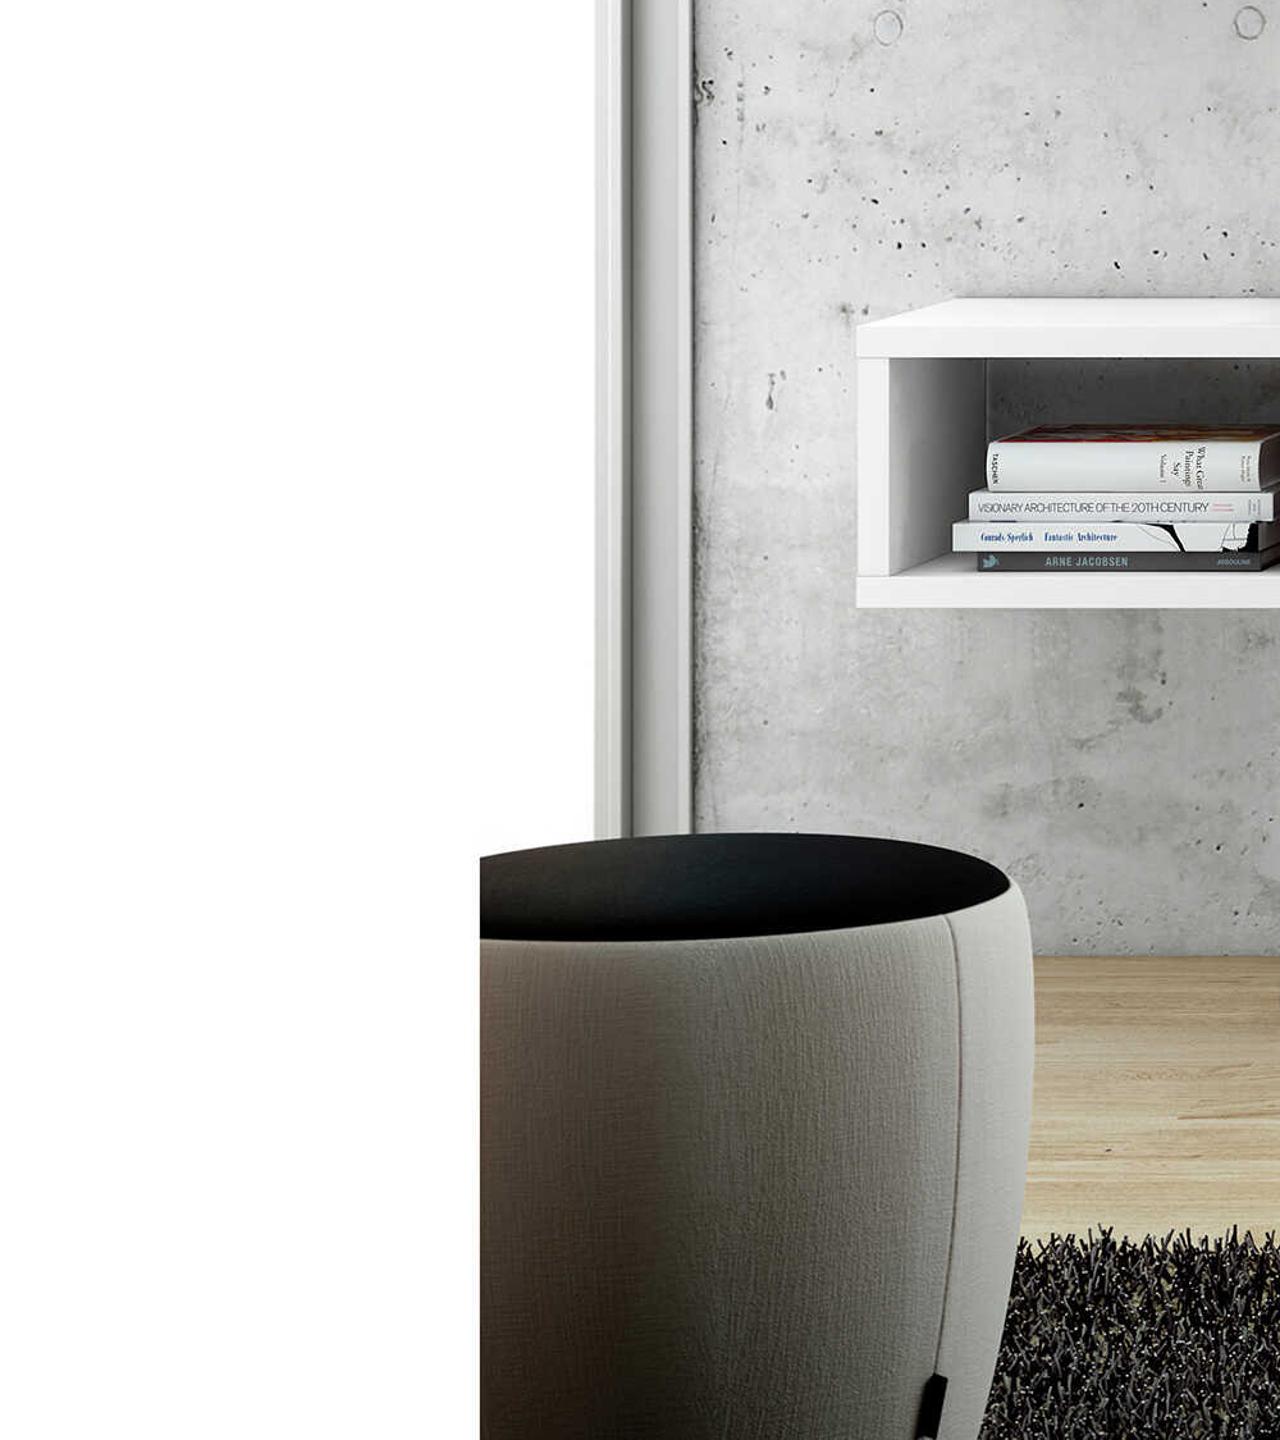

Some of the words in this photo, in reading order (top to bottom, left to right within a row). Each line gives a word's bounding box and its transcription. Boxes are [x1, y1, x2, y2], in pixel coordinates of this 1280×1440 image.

[1170, 461, 1181, 476] Say
[977, 502, 1024, 514] VISIONARY
[1023, 502, 1094, 514] ARCHITECTURE
[1094, 502, 1111, 514] OF
[1110, 502, 1130, 514] THE
[1130, 502, 1159, 514] 20TH
[1159, 502, 1209, 514] CENTURY
[1076, 531, 1118, 543] Architecture
[1045, 556, 1073, 567] ARNE
[1075, 556, 1129, 567] JACOBSEN
